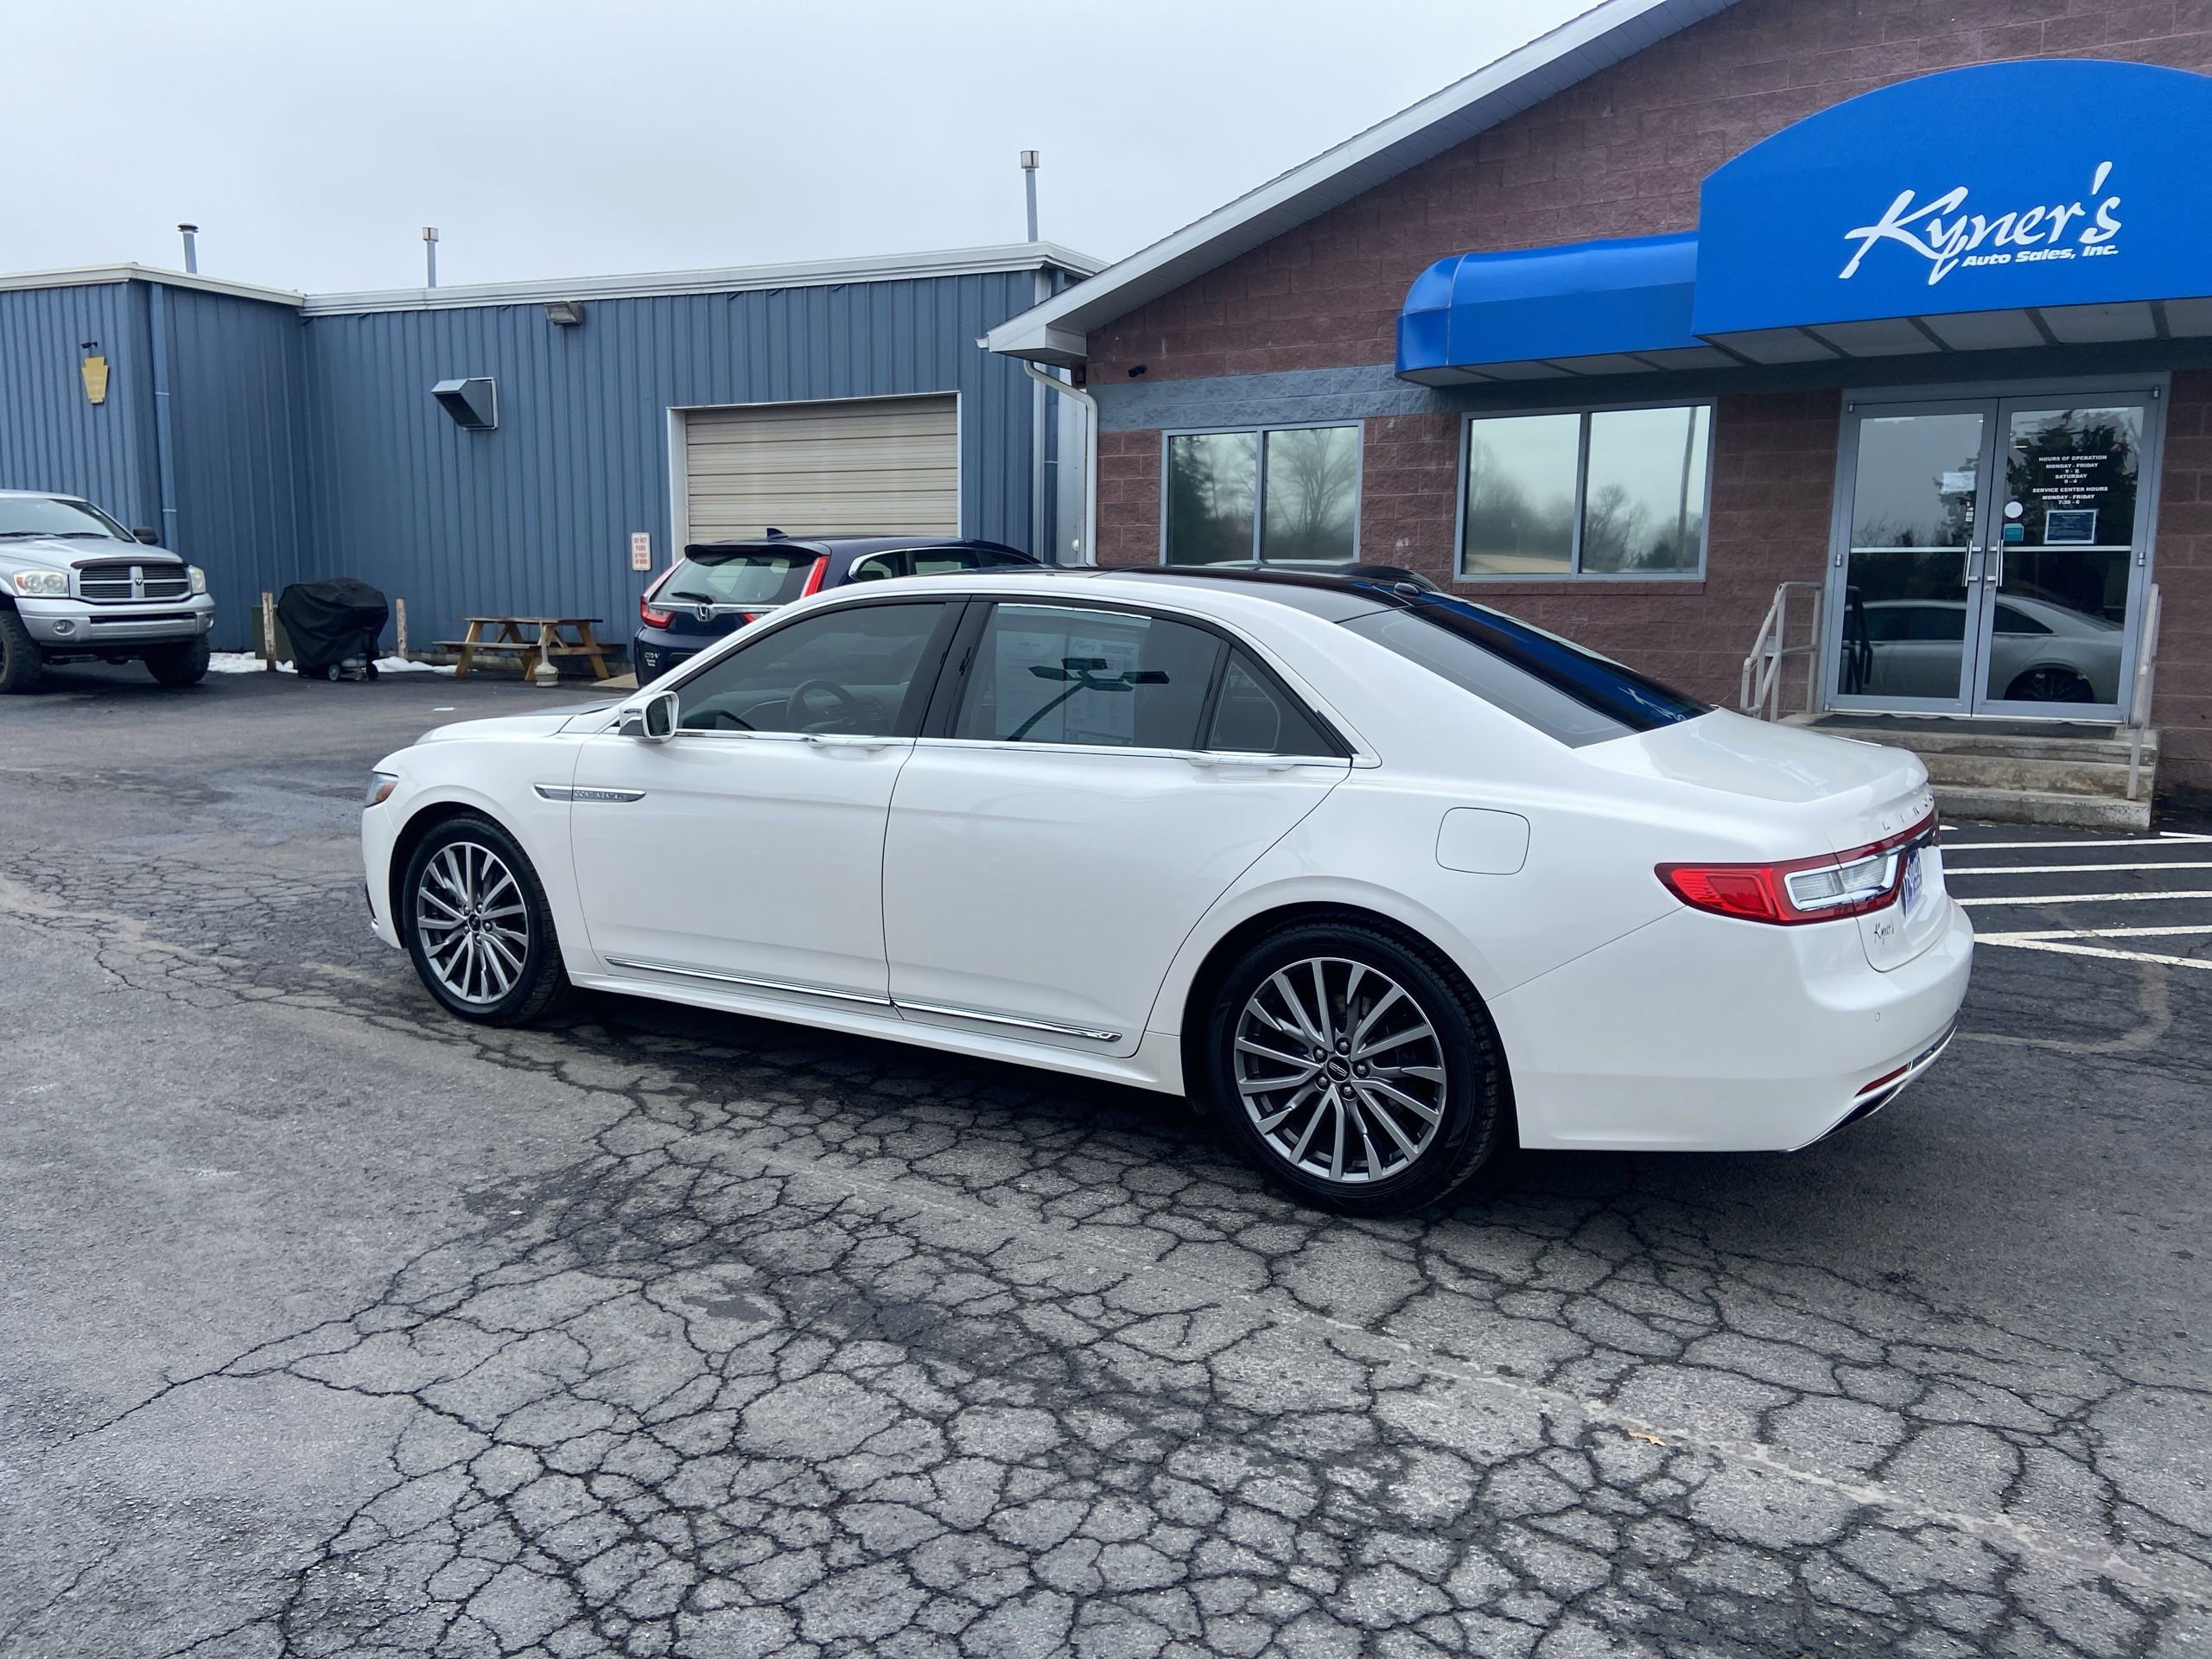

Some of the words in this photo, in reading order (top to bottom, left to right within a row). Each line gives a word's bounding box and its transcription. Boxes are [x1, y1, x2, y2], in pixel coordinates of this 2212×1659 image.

[1839, 161, 2121, 286] Kyner's
[1961, 253, 2012, 267] Auto
[2015, 248, 2076, 263] Sales,
[2082, 245, 2119, 257] Inc.
